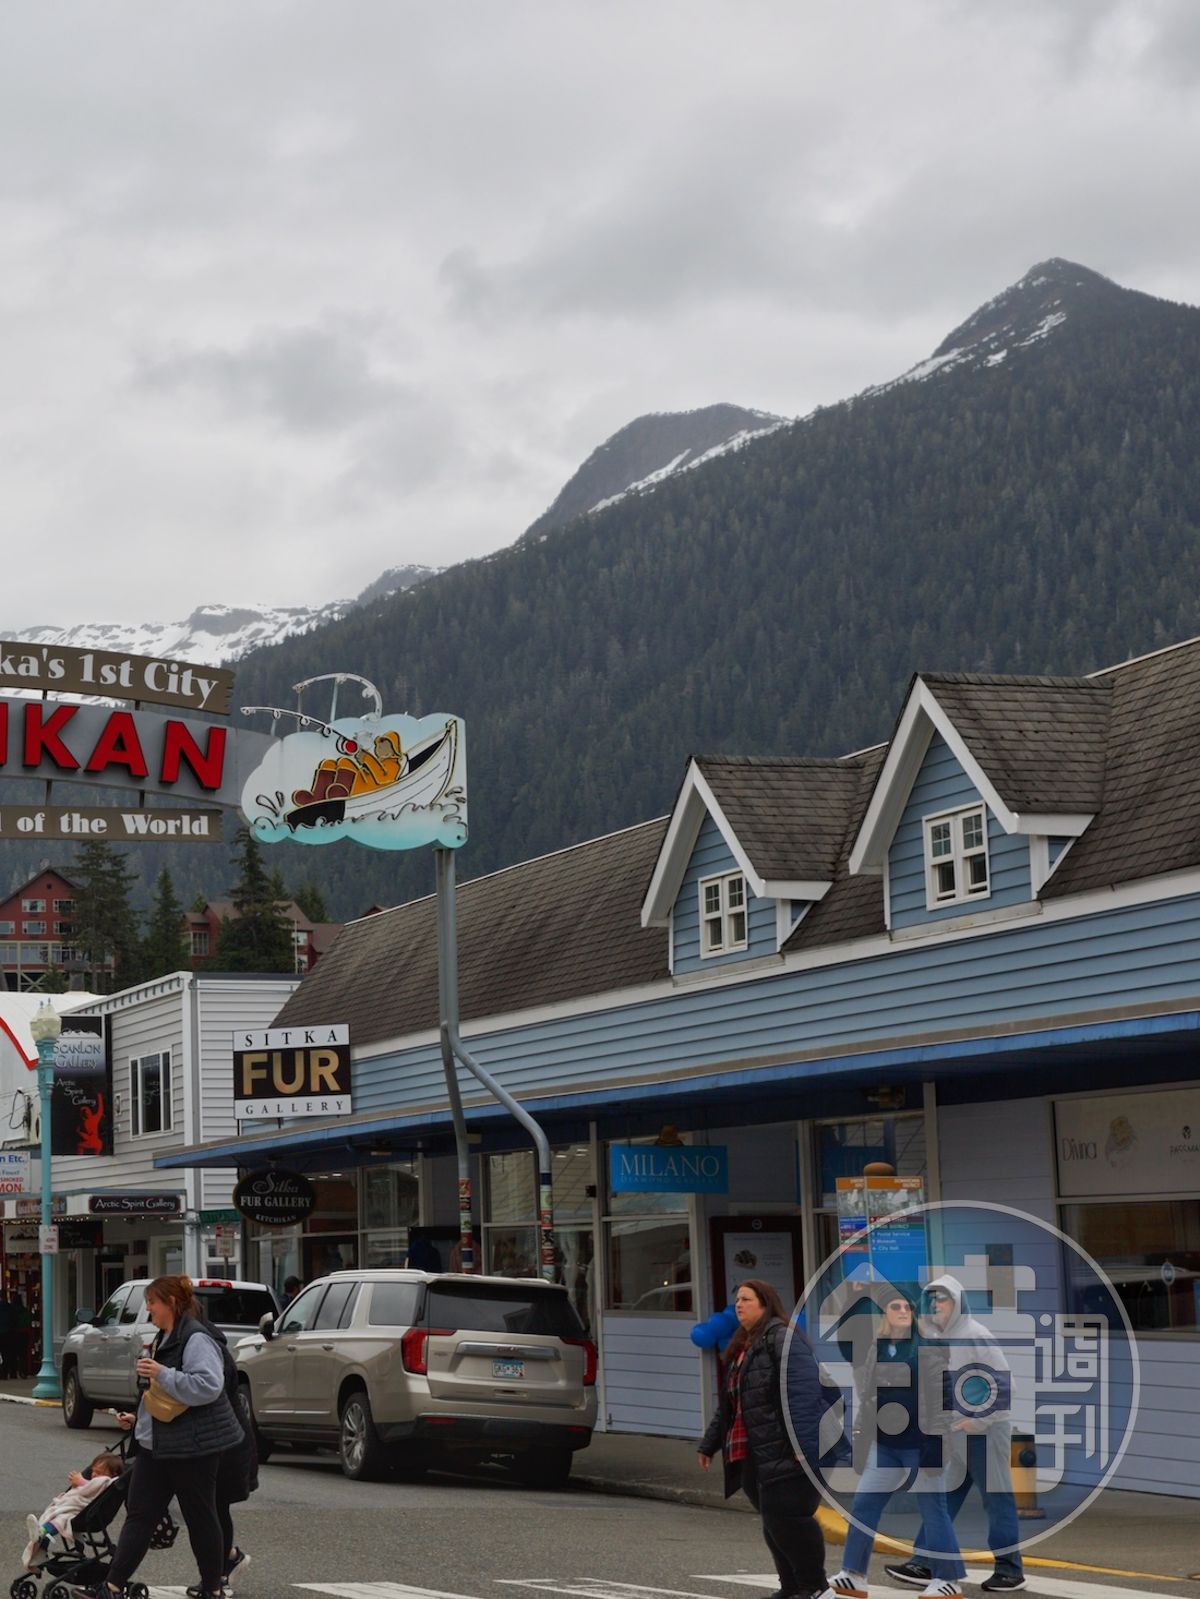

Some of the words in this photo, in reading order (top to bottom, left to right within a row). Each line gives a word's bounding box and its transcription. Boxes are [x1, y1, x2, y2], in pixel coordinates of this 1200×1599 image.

[78, 652, 134, 688] 1st
[144, 662, 219, 710] City
[17, 811, 46, 833] of
[60, 811, 107, 834] the
[121, 814, 209, 836] World
[245, 1029, 337, 1047] SITKA
[242, 1048, 342, 1097] FUR
[246, 1100, 343, 1114] GALLERY
[9, 1154, 25, 1163] Etc.
[620, 1153, 720, 1177] MILANO
[252, 1172, 298, 1194] Sitka
[95, 1199, 120, 1209] Arctic
[121, 1198, 145, 1210] Spirit
[146, 1198, 175, 1209] Gallery
[240, 1195, 262, 1207] FUR
[264, 1195, 312, 1208] GALLERY
